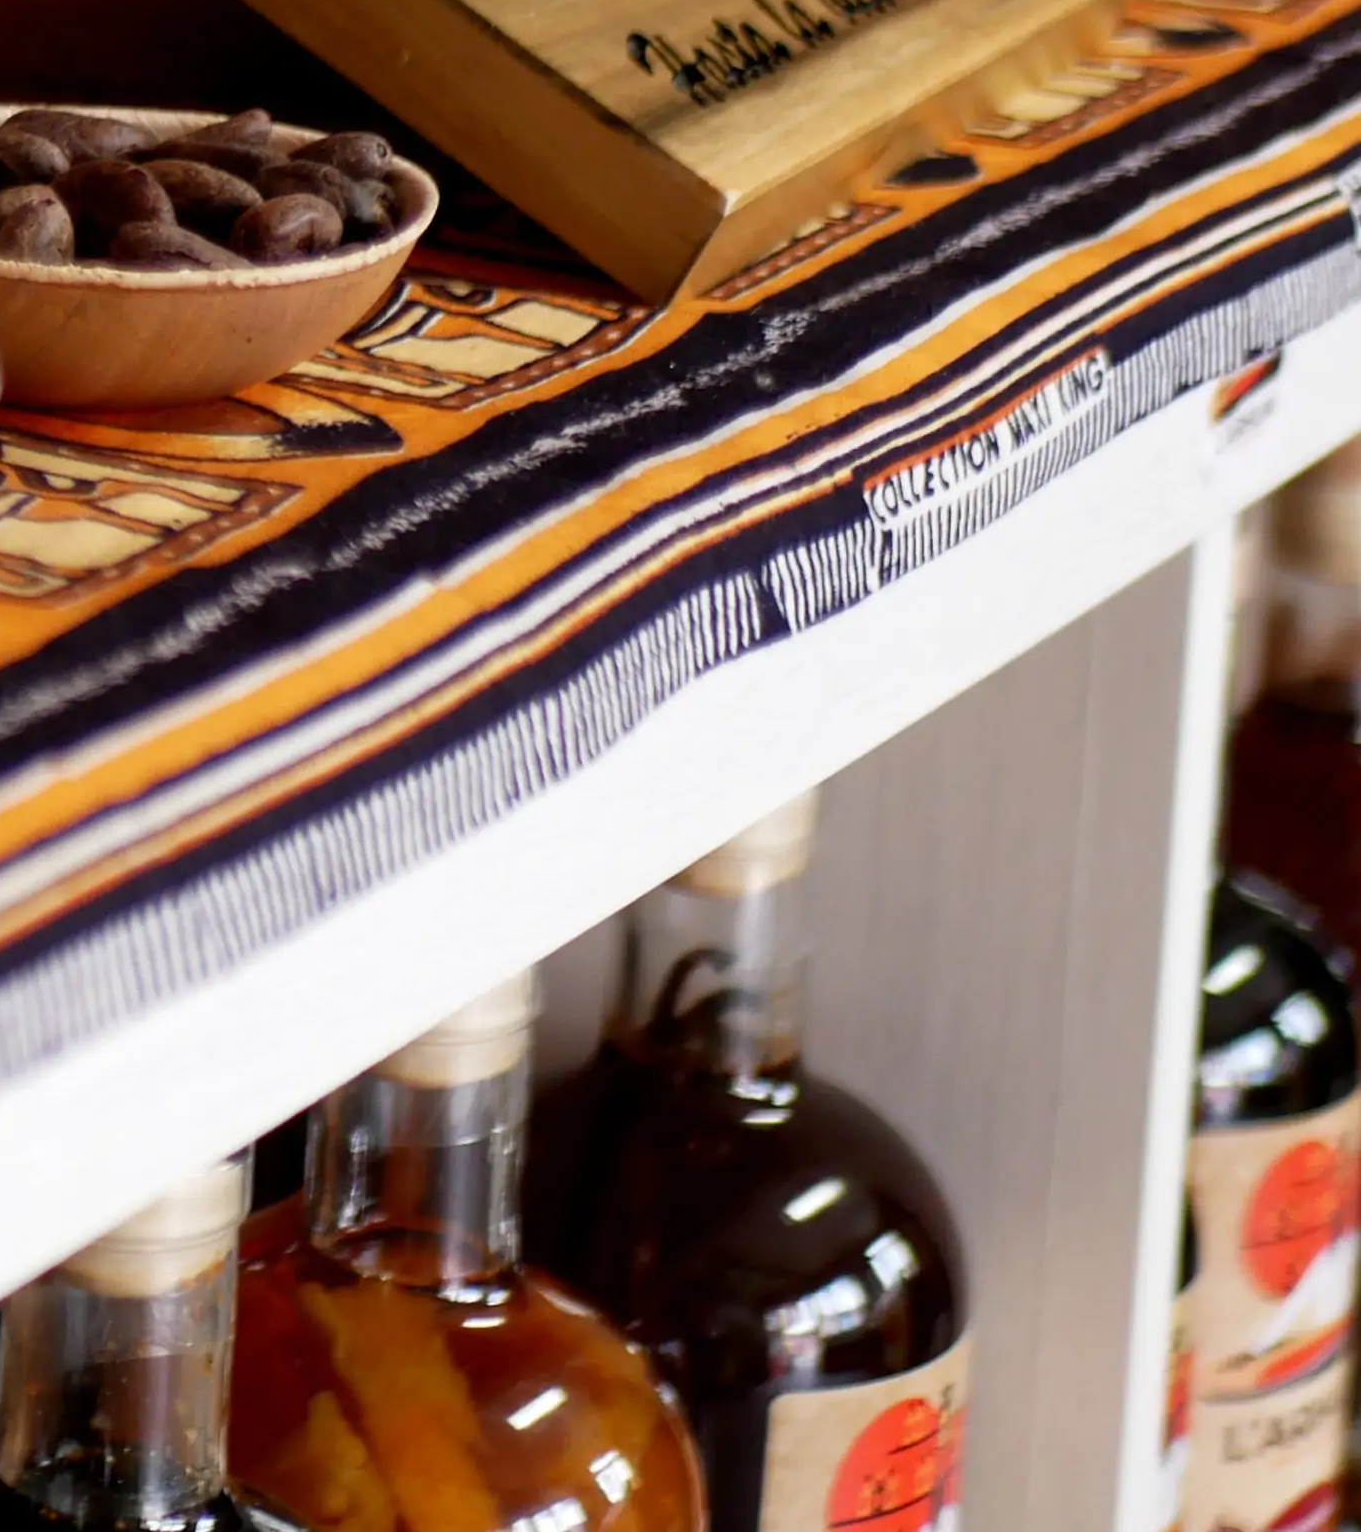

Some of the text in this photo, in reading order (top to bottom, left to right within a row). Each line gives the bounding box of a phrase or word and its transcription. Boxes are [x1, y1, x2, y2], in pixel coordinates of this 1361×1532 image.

[869, 355, 1104, 524] COLLECTION MAXI KING
